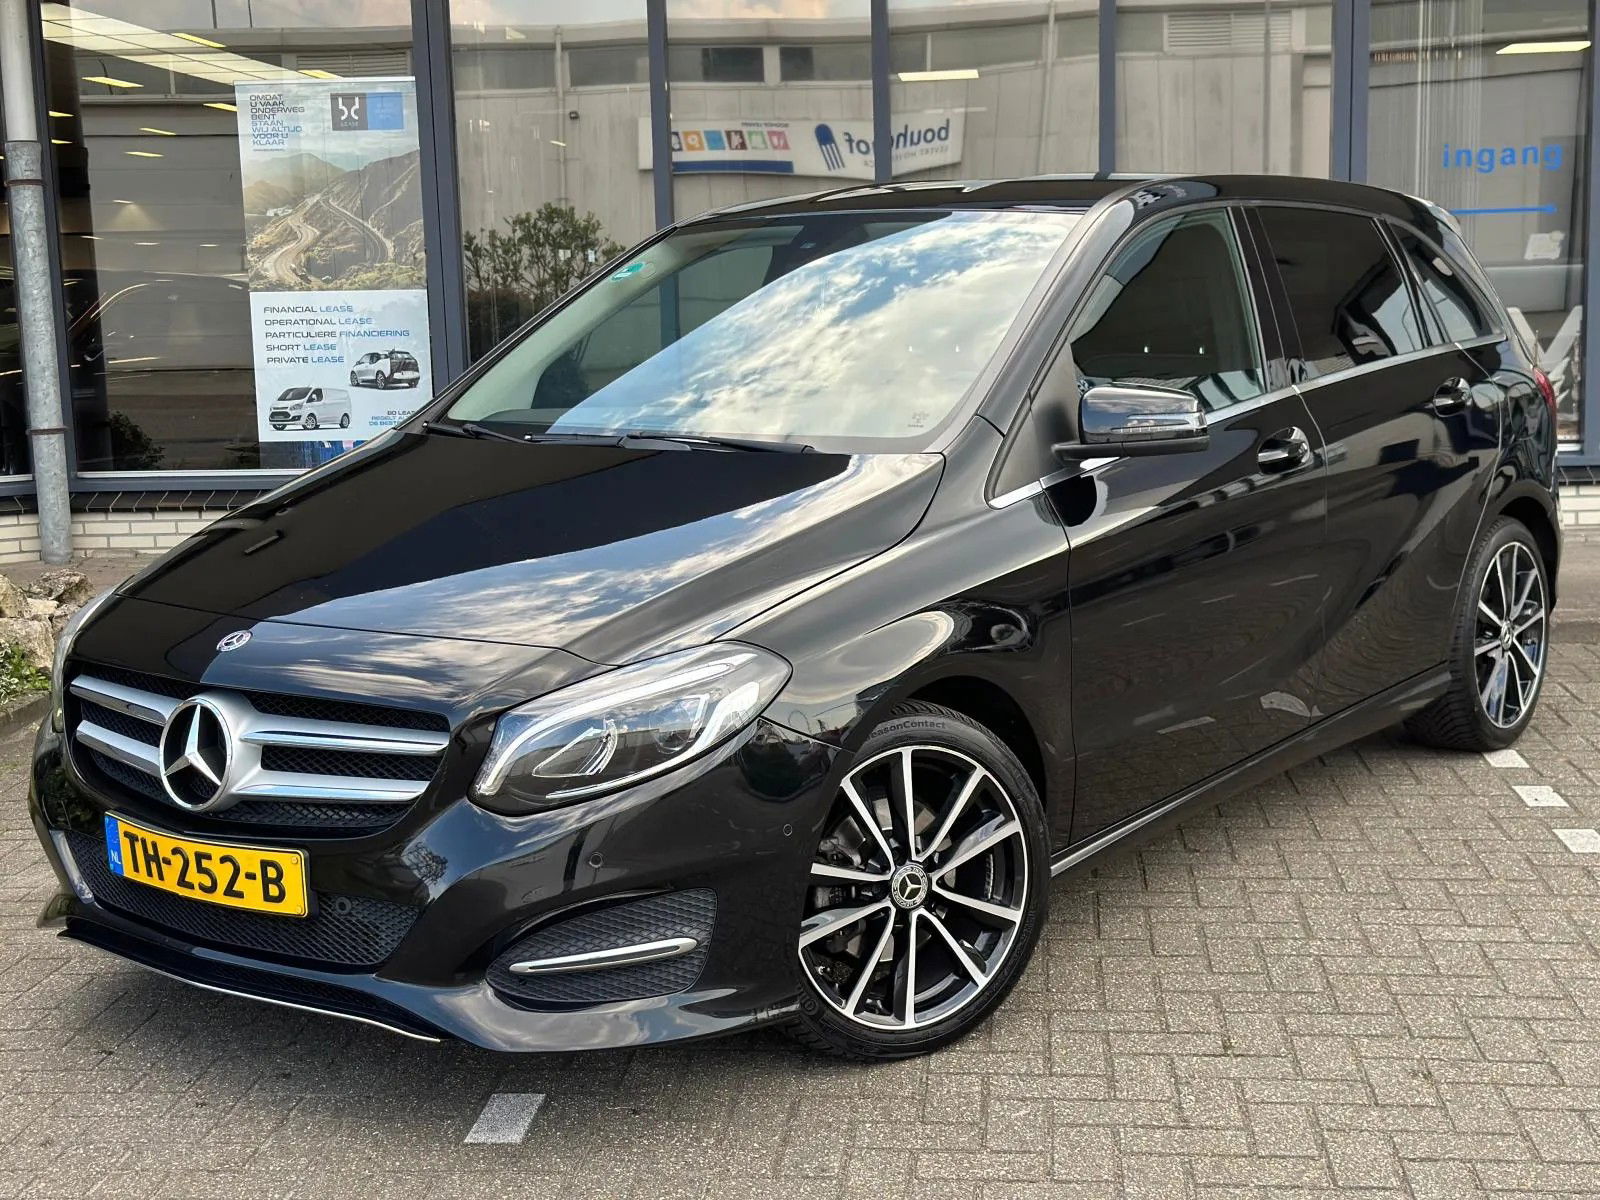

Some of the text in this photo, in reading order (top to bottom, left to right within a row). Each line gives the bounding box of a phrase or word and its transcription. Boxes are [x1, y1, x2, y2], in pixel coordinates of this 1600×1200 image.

[1442, 144, 1563, 174] ingang
[264, 318, 337, 326] OPERATIONAL
[265, 331, 337, 339] PARTICULIERE
[110, 830, 286, 903] NL TH-252-B
